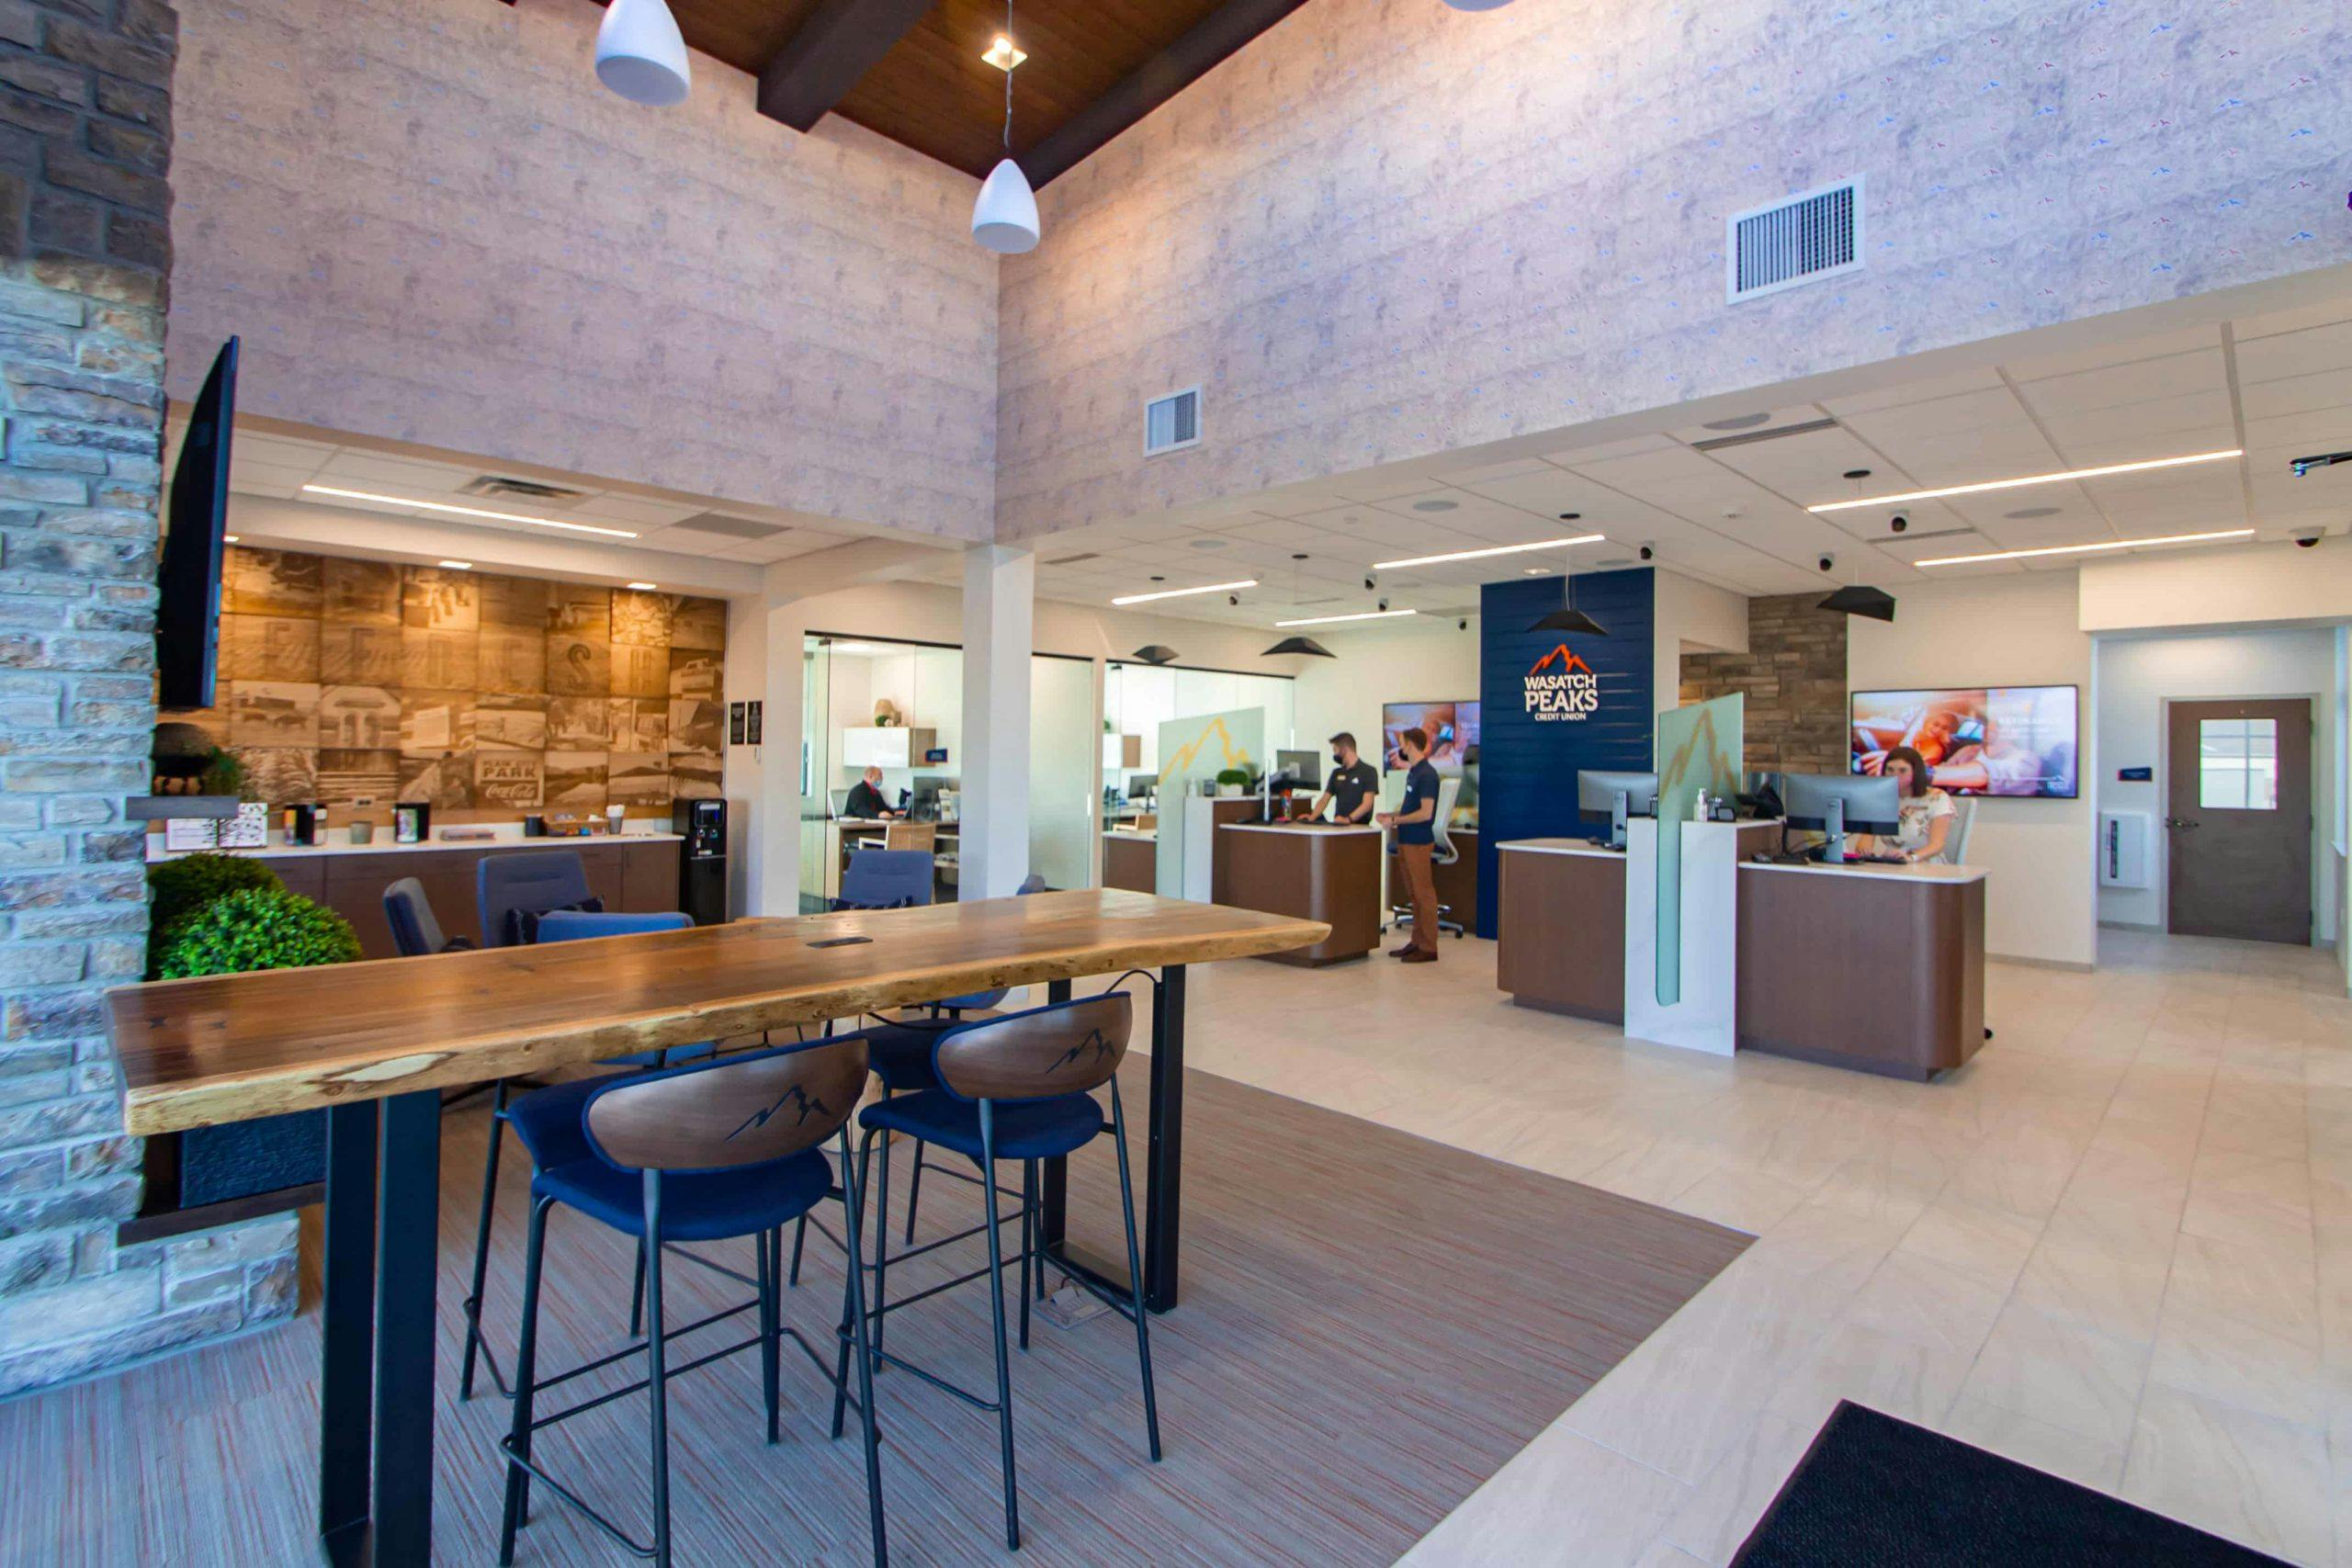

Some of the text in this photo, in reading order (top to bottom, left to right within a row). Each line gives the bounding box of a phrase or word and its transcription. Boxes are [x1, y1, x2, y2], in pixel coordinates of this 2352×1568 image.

[1524, 674, 1598, 690] WASATCH
[1524, 689, 1599, 713] PEAKS
[1534, 713, 1587, 721] CREDIT UNION
[483, 767, 536, 778] PARK
